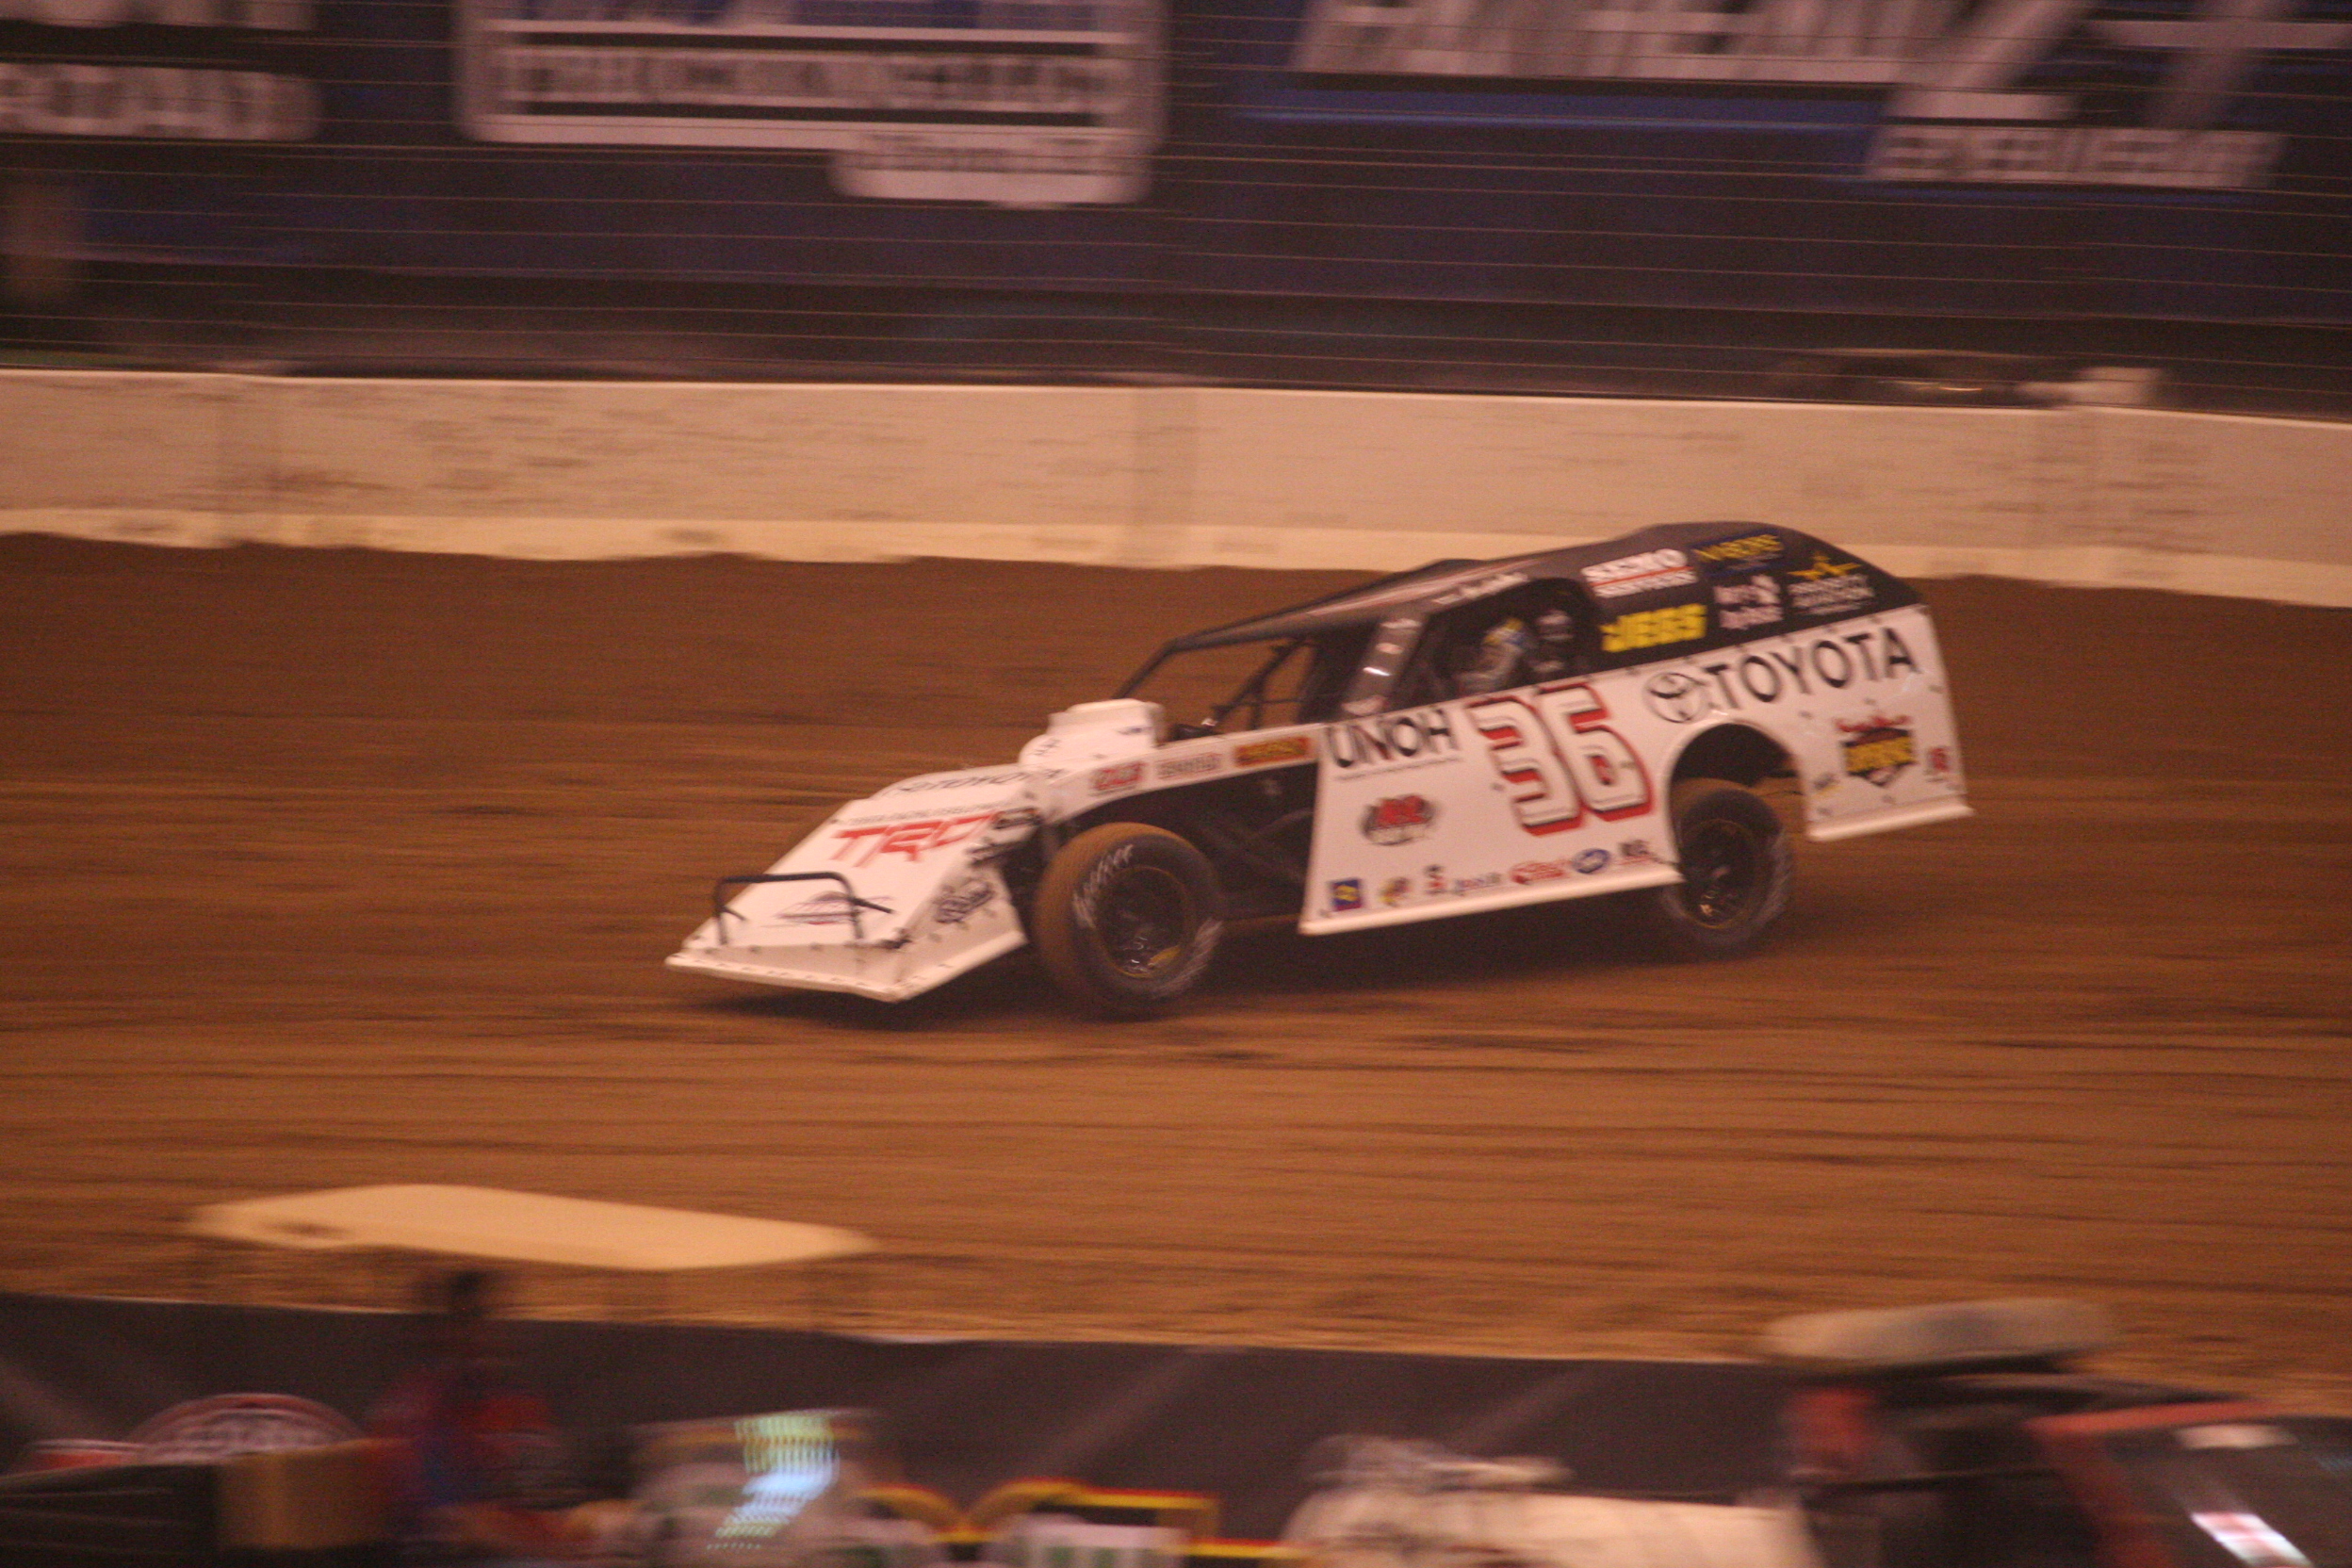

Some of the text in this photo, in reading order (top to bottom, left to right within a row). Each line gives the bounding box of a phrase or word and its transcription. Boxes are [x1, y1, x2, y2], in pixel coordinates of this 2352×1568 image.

[1706, 627, 1922, 710] TOYOTA
[1326, 709, 1461, 768] UNOH
[1465, 680, 1655, 837] 36
[829, 808, 999, 868] TRD
